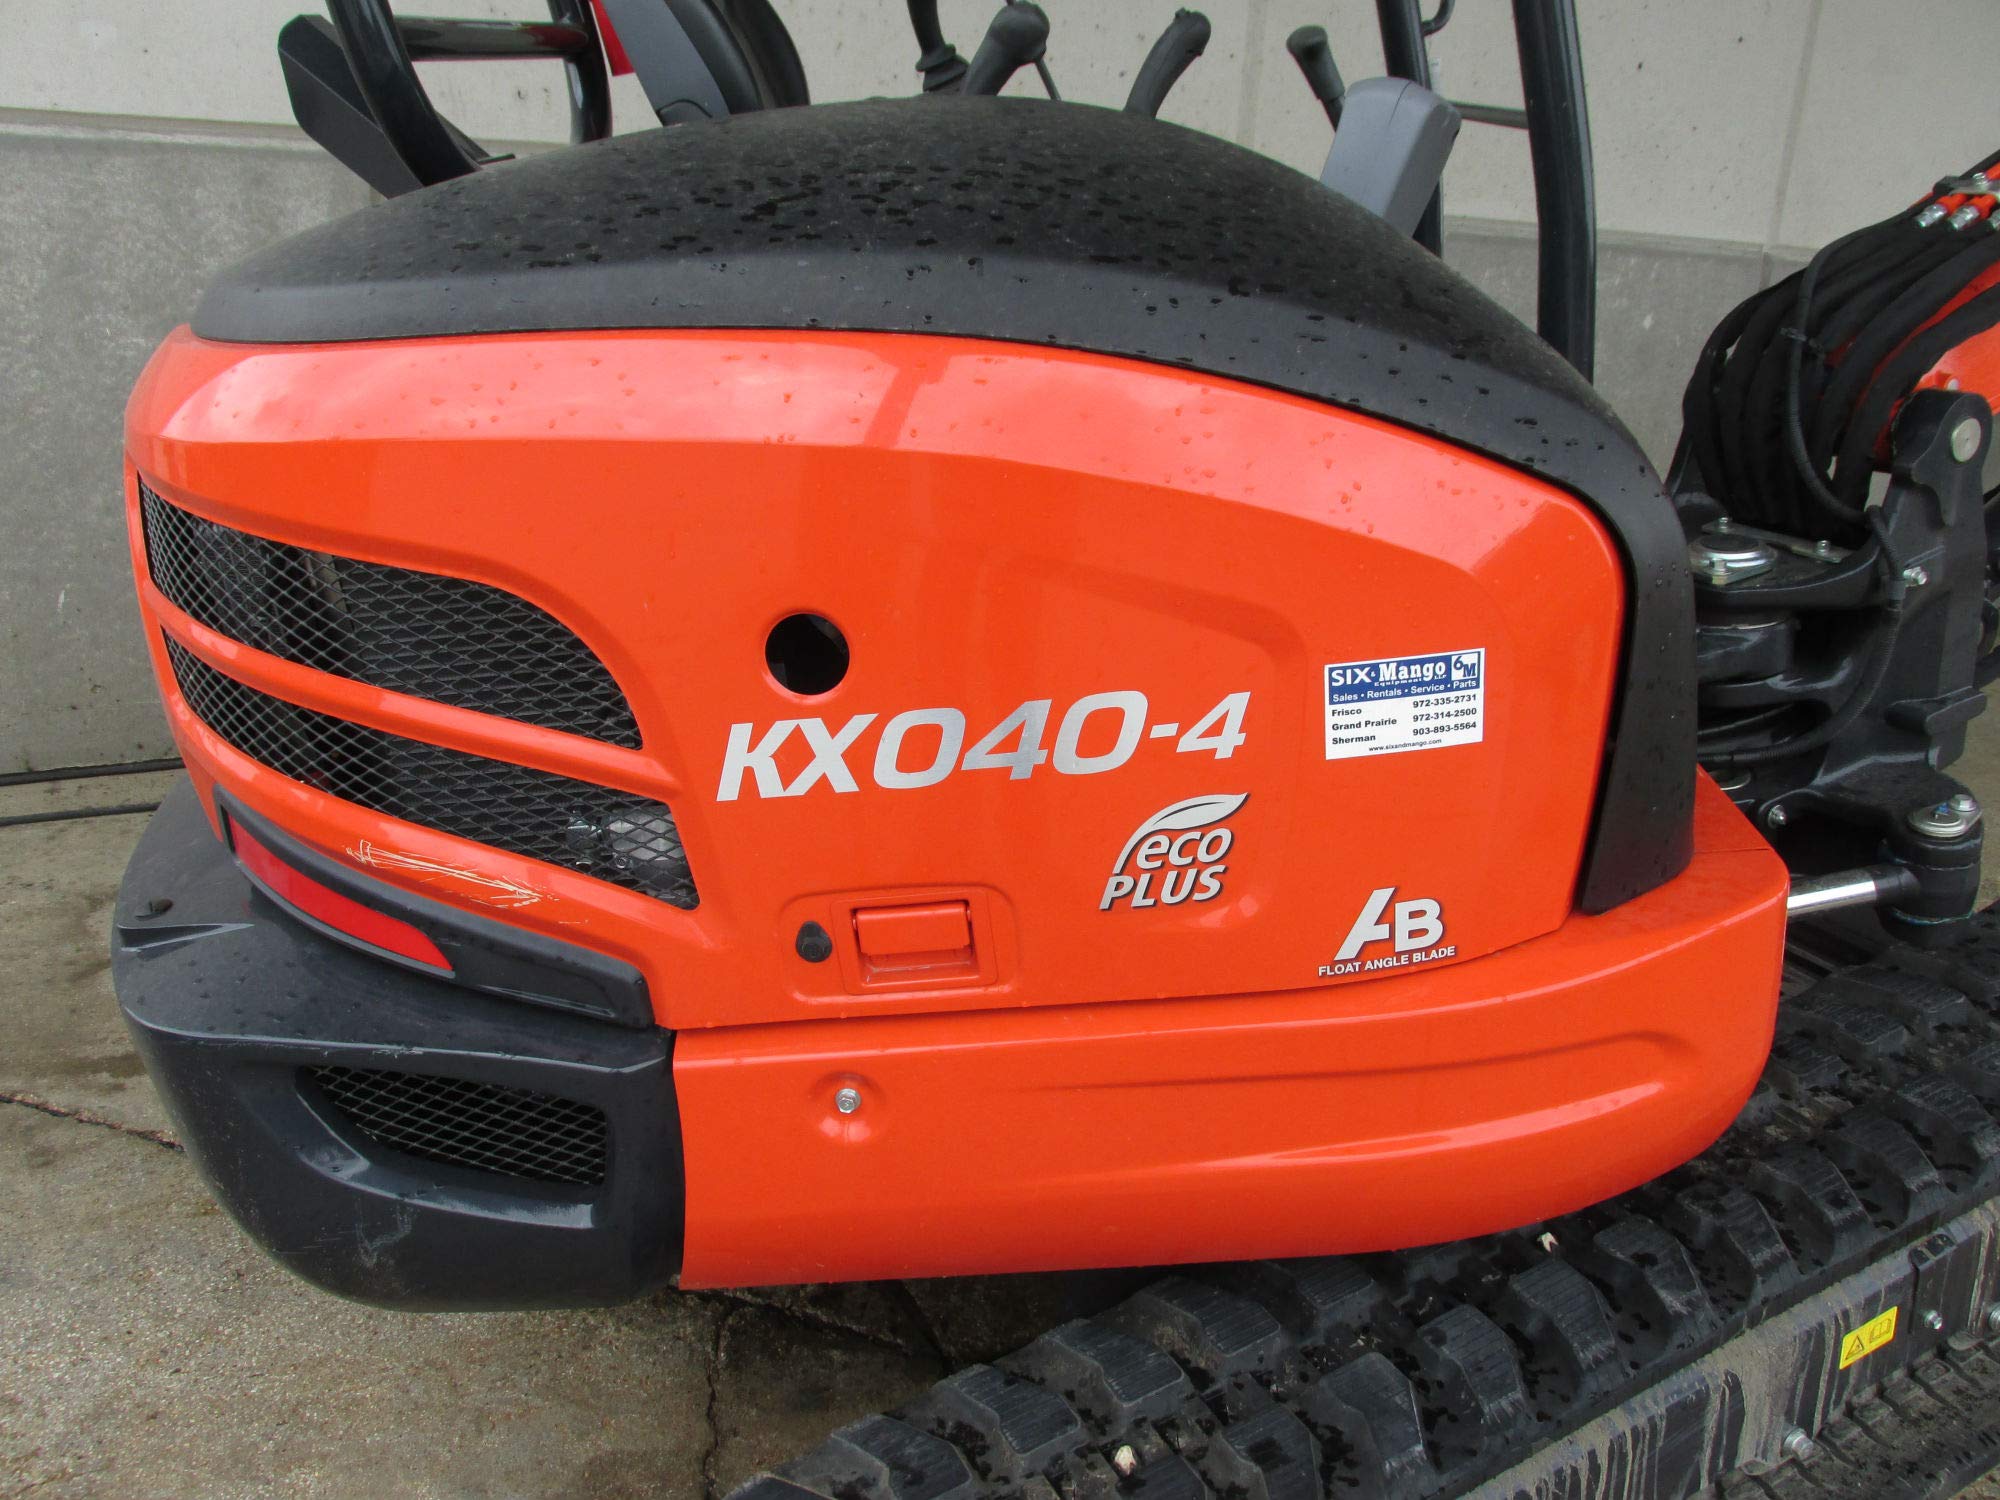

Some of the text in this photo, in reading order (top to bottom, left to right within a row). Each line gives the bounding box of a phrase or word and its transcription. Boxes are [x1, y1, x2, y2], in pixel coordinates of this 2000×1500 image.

[1331, 666, 1371, 686] SIX
[1378, 661, 1446, 682] Mango
[1333, 680, 1476, 702] Sales Rentals Service Parts
[1331, 694, 1476, 717] Frisco 972-335-2731
[1332, 707, 1477, 731] Grand Prairie 972-314-2500
[1332, 721, 1476, 745] Sherman 903-893-5564
[1369, 738, 1442, 752] www.sixandmango.com
[716, 690, 1251, 801] KX040-4
[1136, 828, 1234, 869] eco
[1099, 865, 1228, 911] PLUS
[1318, 946, 1456, 977] FLOAT ANGLE BLADE
